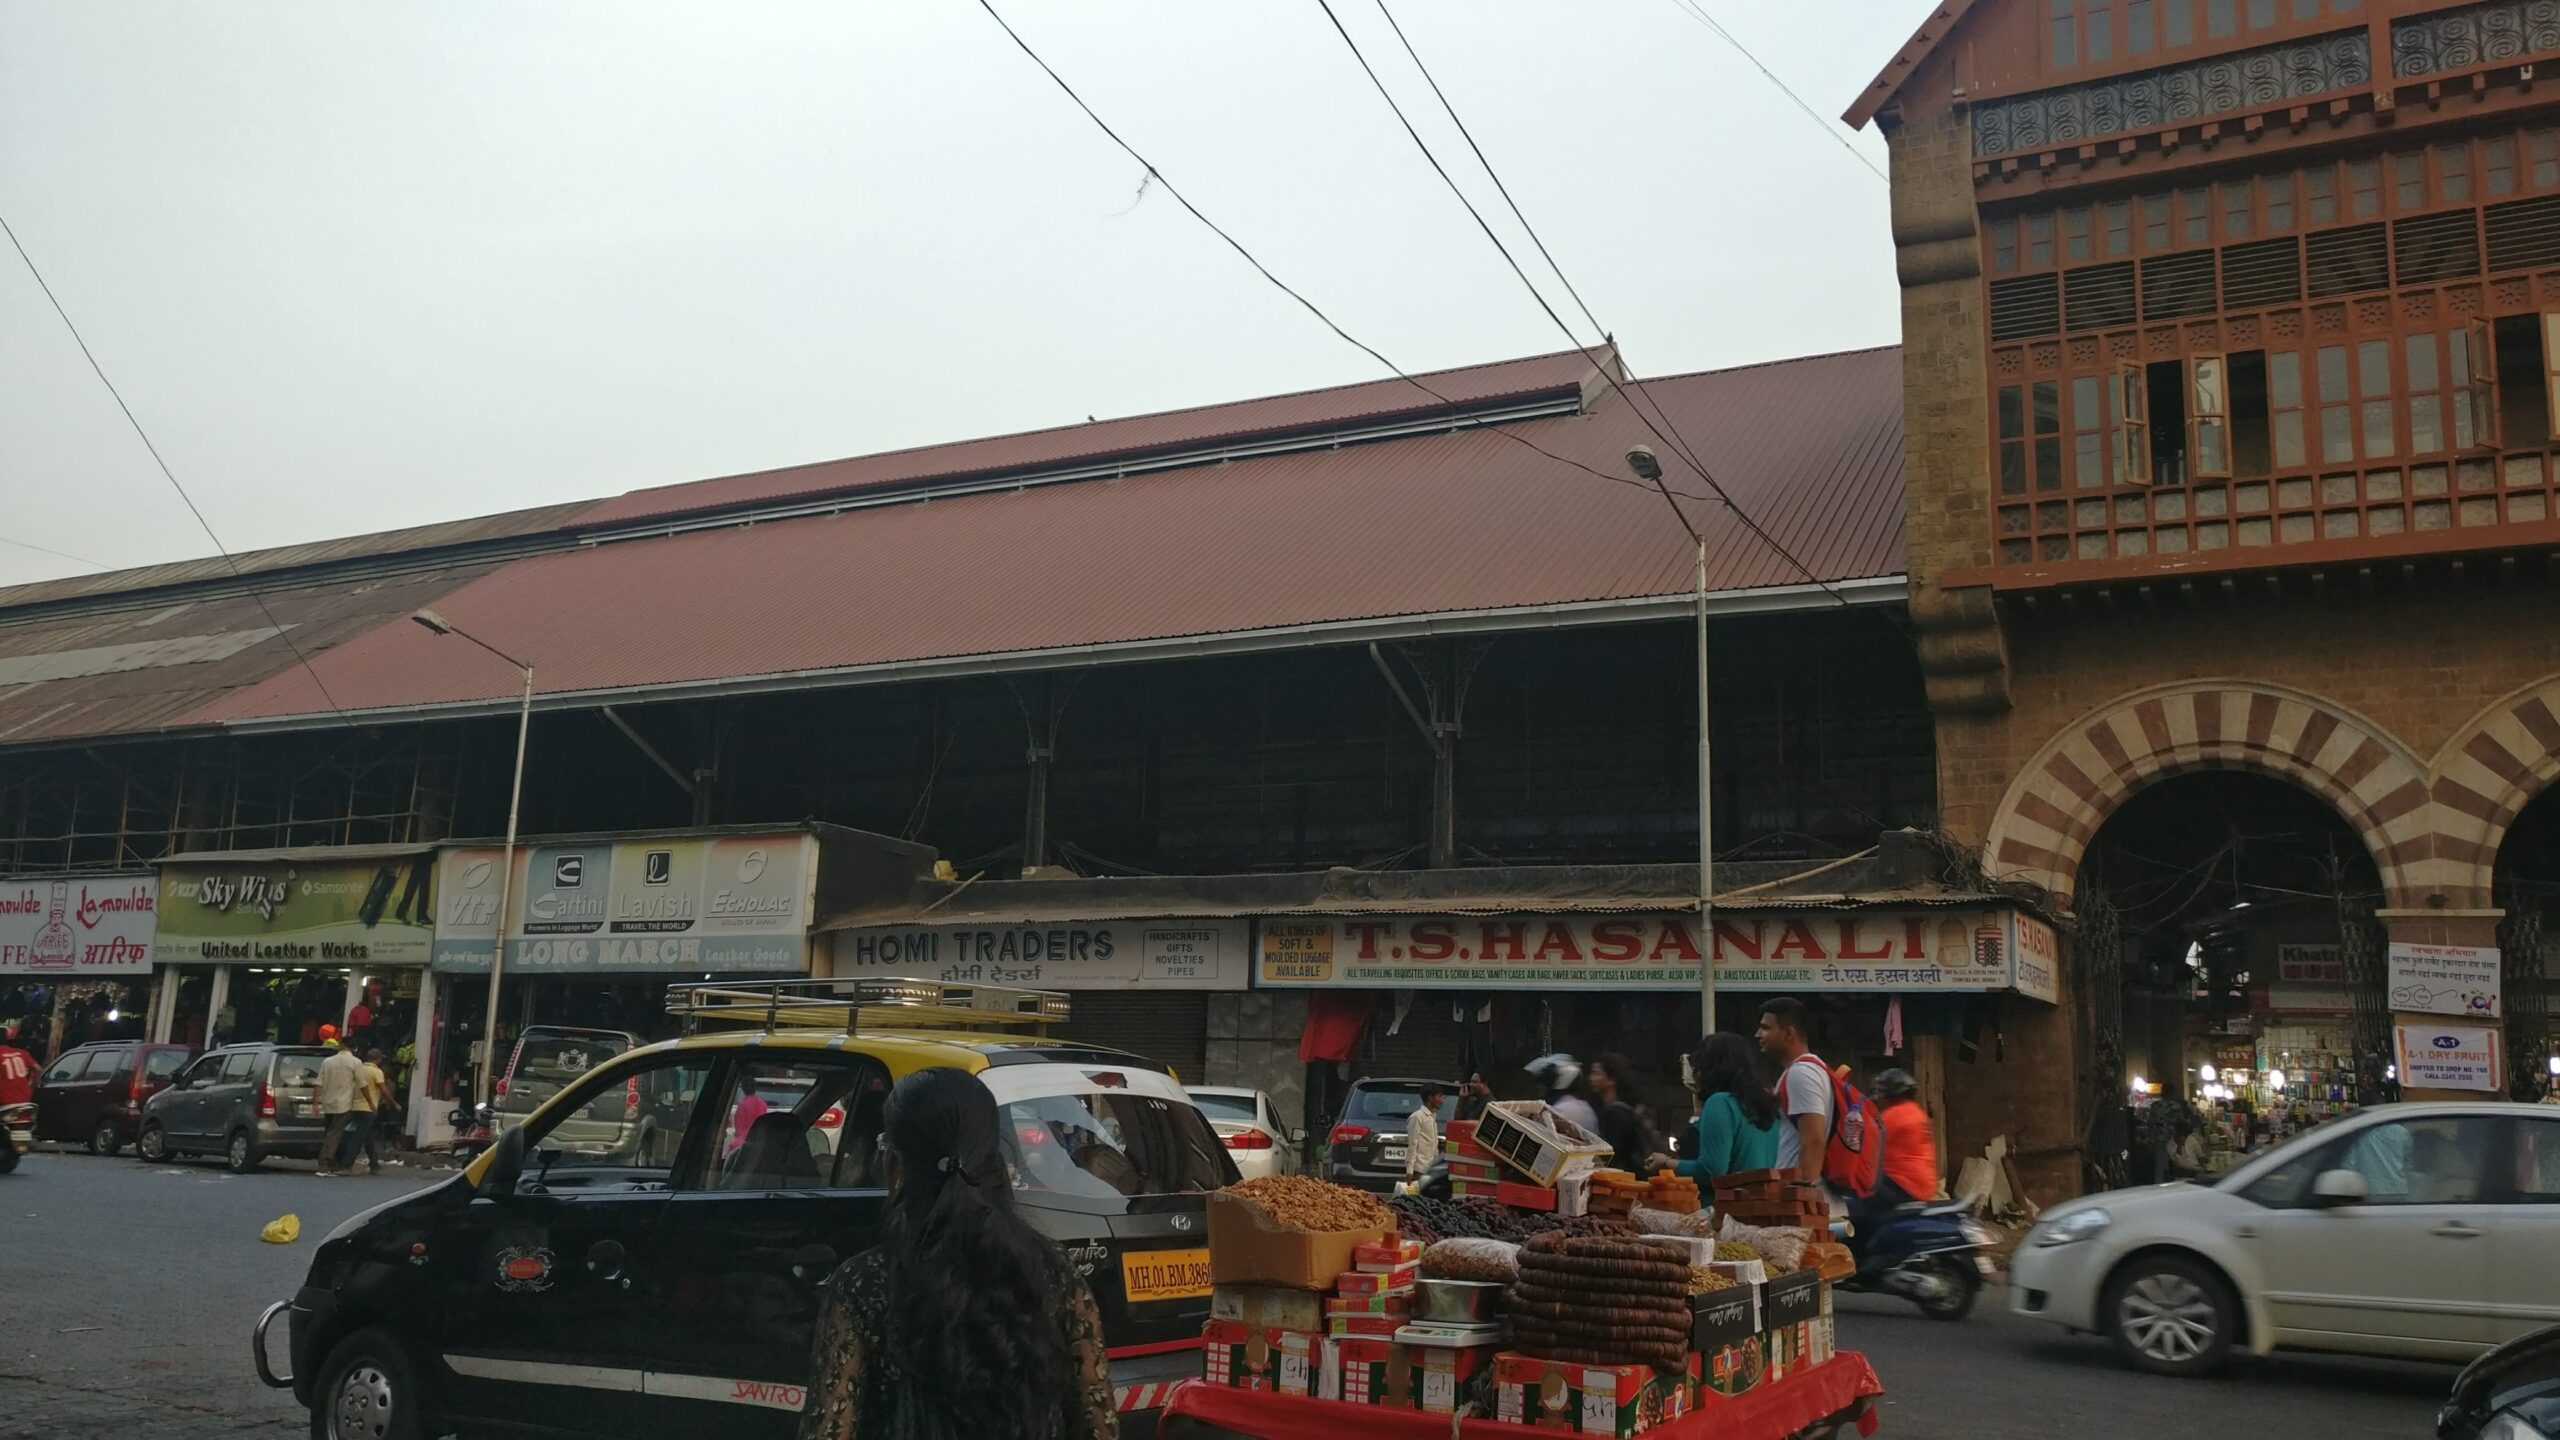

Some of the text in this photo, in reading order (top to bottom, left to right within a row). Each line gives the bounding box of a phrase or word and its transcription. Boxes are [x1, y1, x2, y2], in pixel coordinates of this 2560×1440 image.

[199, 876, 236, 910] Sky
[448, 895, 501, 926] VIP
[531, 892, 605, 919] Cartini
[619, 891, 694, 918] Lavish
[623, 923, 687, 931] TRAVEL THE WORLD
[1269, 925, 1284, 936] ALL
[1316, 925, 1327, 936] OF
[1149, 931, 1210, 941] HANDICRAFTS
[81, 936, 148, 964] आरिफ
[202, 942, 250, 959] United
[255, 942, 314, 959] Leather
[321, 942, 369, 959] Works
[517, 941, 590, 964] LONG
[598, 939, 701, 964] MARCH
[856, 930, 1115, 965] HOMI TRADERS
[1167, 944, 1193, 953] GIFTS
[1279, 938, 1314, 950] SOFT &
[705, 947, 790, 962] Leather Goods
[1156, 956, 1205, 965] NOVELTIES
[1264, 952, 1330, 963] MOULDED LUGGAGE
[941, 965, 983, 982] होमी
[1168, 967, 1195, 977] PIPES
[1276, 966, 1321, 977] AVAILABLE
[1347, 968, 1358, 978] ALL
[1360, 968, 1393, 978] TRAVELLING
[1449, 969, 1471, 979] SCHOOL
[1487, 969, 1507, 979] VANITY
[1588, 970, 1619, 980] SUITCASES
[1626, 970, 1645, 980] LADIES
[1668, 970, 1683, 980] ALSO
[1724, 970, 1767, 980] ARISTOCRATE
[1769, 970, 1798, 980] LUGGAGE
[2408, 1050, 2488, 1061] A-1 DRY FRUIT
[3, 1056, 28, 1080] 10
[2409, 1064, 2435, 1072] SHIFTED
[2445, 1065, 2461, 1073] SHOP
[1128, 1262, 1211, 1290] MH.01.BM.386
[731, 1381, 802, 1405] SANTRO
